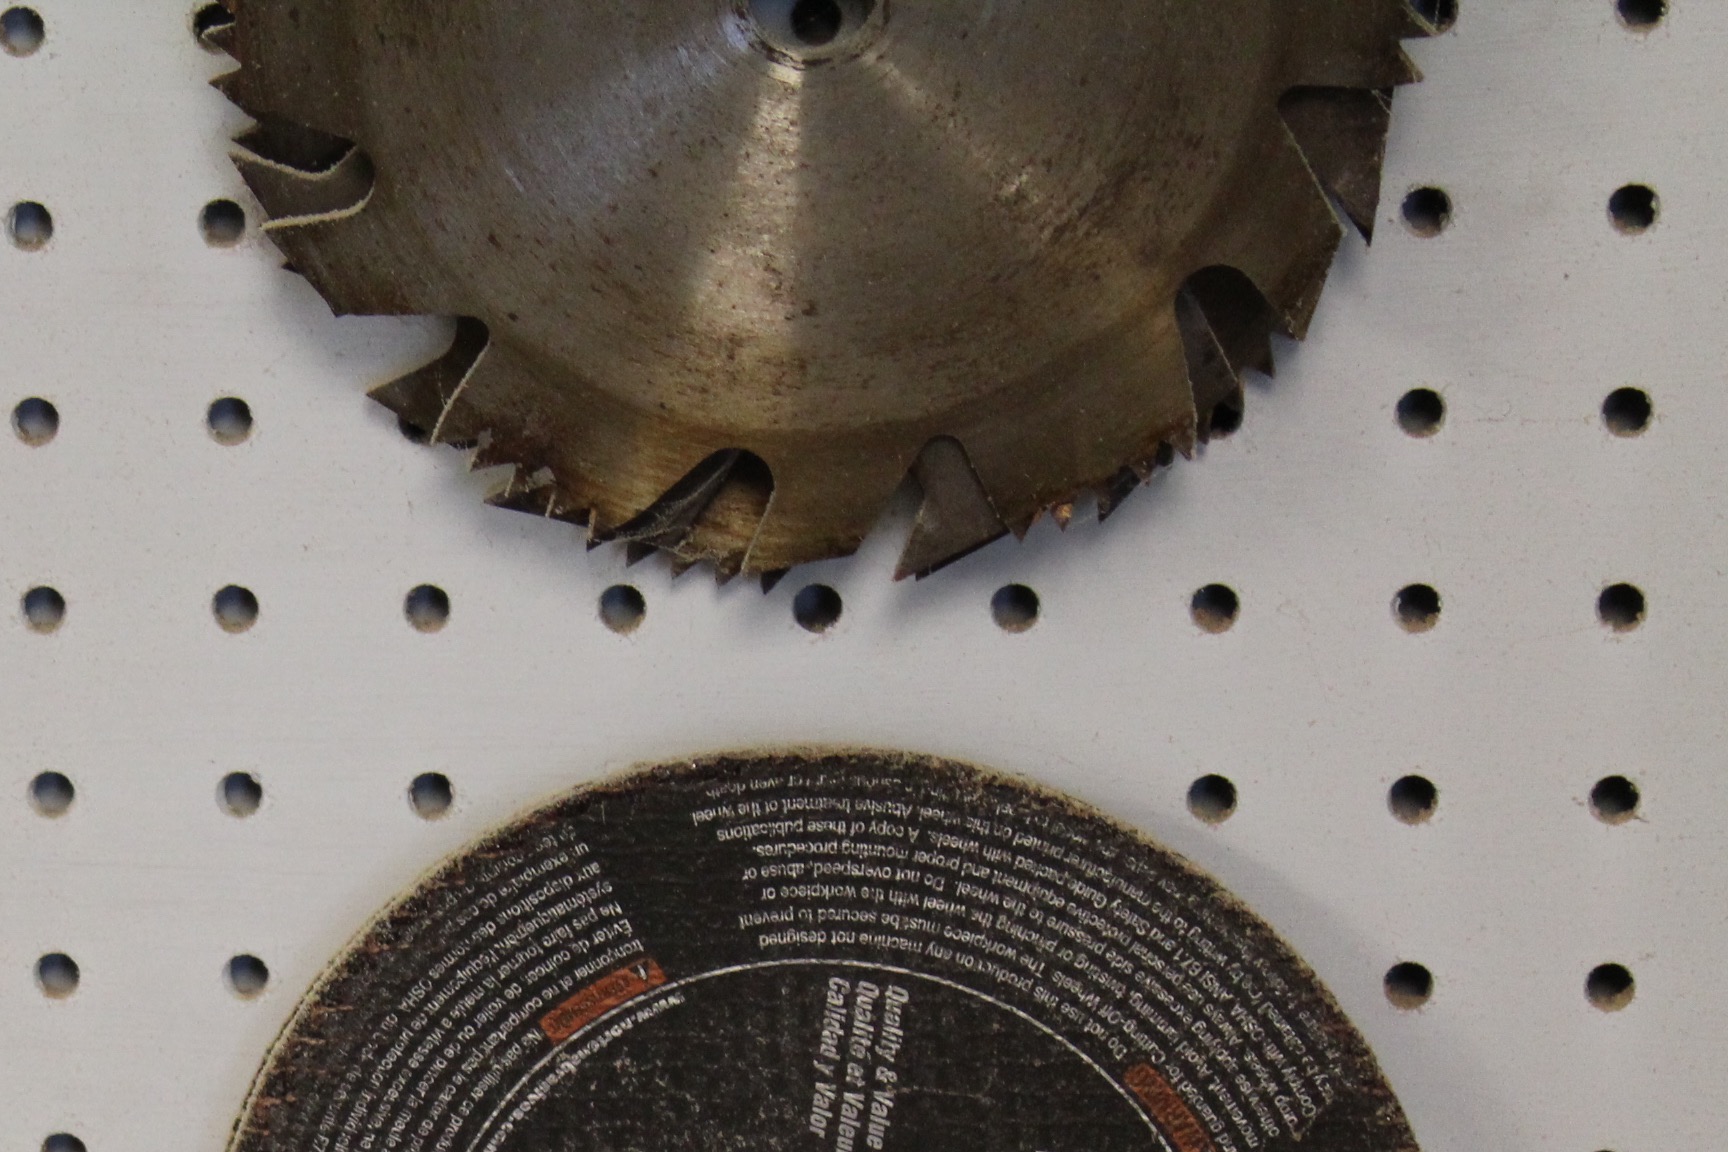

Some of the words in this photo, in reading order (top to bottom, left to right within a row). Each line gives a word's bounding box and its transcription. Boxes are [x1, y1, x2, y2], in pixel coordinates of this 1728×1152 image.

[740, 866, 757, 880] or
[759, 861, 804, 880] abuse
[808, 858, 892, 880] overspeed,
[894, 867, 920, 885] not
[759, 885, 775, 900] or
[779, 882, 855, 902] workpiece
[923, 873, 945, 891] Do
[859, 886, 884, 903] the
[887, 889, 919, 908] with
[1001, 896, 1025, 916] the
[600, 900, 621, 919] Ne
[737, 904, 793, 929] prevent
[797, 907, 812, 923] to
[817, 907, 877, 924] secured
[922, 894, 966, 919] wheel
[968, 907, 992, 928] the
[1026, 907, 1043, 923] to
[571, 908, 597, 930] pas
[880, 911, 899, 929] be
[903, 916, 940, 936] must
[542, 925, 572, 950] faire
[592, 918, 632, 949] Éviter
[758, 926, 826, 949] designed
[830, 929, 855, 945] not
[858, 931, 922, 954] machine
[942, 923, 1018, 962] workpiece
[994, 914, 1057, 954] pinching
[1045, 913, 1106, 954] pressure
[571, 937, 591, 956] de
[572, 932, 648, 981] tronçonner
[924, 940, 952, 960] any
[1057, 945, 1073, 961] or
[497, 943, 542, 981] tourner
[954, 951, 974, 968] on
[1018, 953, 1046, 976] The
[1104, 949, 1133, 975] side
[558, 975, 573, 991] et
[976, 957, 1032, 993] product
[1073, 953, 1127, 996] twisting
[504, 983, 522, 1001] de
[541, 984, 558, 1000] ne
[1031, 985, 1058, 1008] this
[1134, 969, 1194, 1024] excessive
[818, 977, 850, 1061] Calidad
[848, 980, 879, 1060] Qualité
[873, 985, 909, 1062] Quality
[1059, 1001, 1085, 1024] use
[1084, 1018, 1107, 1041] not
[1099, 1001, 1168, 1064] Cutting-Off
[1105, 1036, 1127, 1059] Do
[1190, 1021, 1239, 1074] applying
[811, 1059, 833, 1078] y
[1175, 1041, 1211, 1078] Avoid
[844, 1063, 865, 1088] et
[874, 1066, 897, 1083] &
[1161, 1062, 1182, 1082] for
[807, 1082, 837, 1139] Valor
[1178, 1079, 1224, 1133] guarded
[1206, 1076, 1259, 1148] movement.
[864, 1090, 894, 1151] Value
